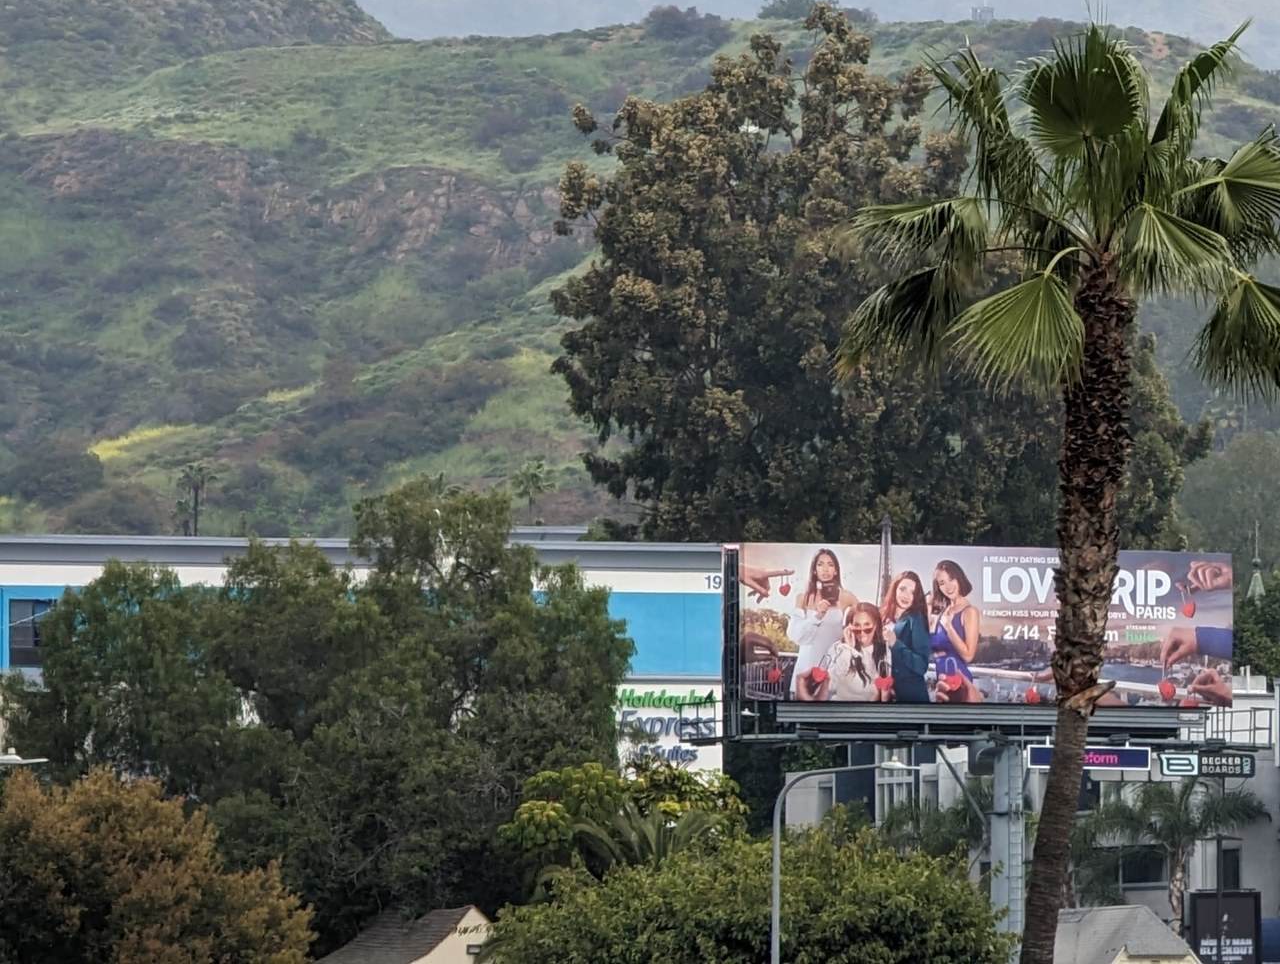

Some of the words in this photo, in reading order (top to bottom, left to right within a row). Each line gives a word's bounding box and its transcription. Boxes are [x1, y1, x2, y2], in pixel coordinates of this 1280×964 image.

[989, 556, 1018, 564] REALITY
[1020, 556, 1046, 564] DATING
[705, 575, 722, 589] 19
[983, 567, 1059, 604] LOV
[1029, 610, 1050, 618] YOUR
[1135, 606, 1176, 620] PARIS
[1003, 624, 1040, 641] 2/14
[620, 689, 687, 712] Holiday
[619, 710, 716, 738] Express
[1201, 756, 1241, 765] BECKER
[1201, 765, 1241, 774] BOARDS
